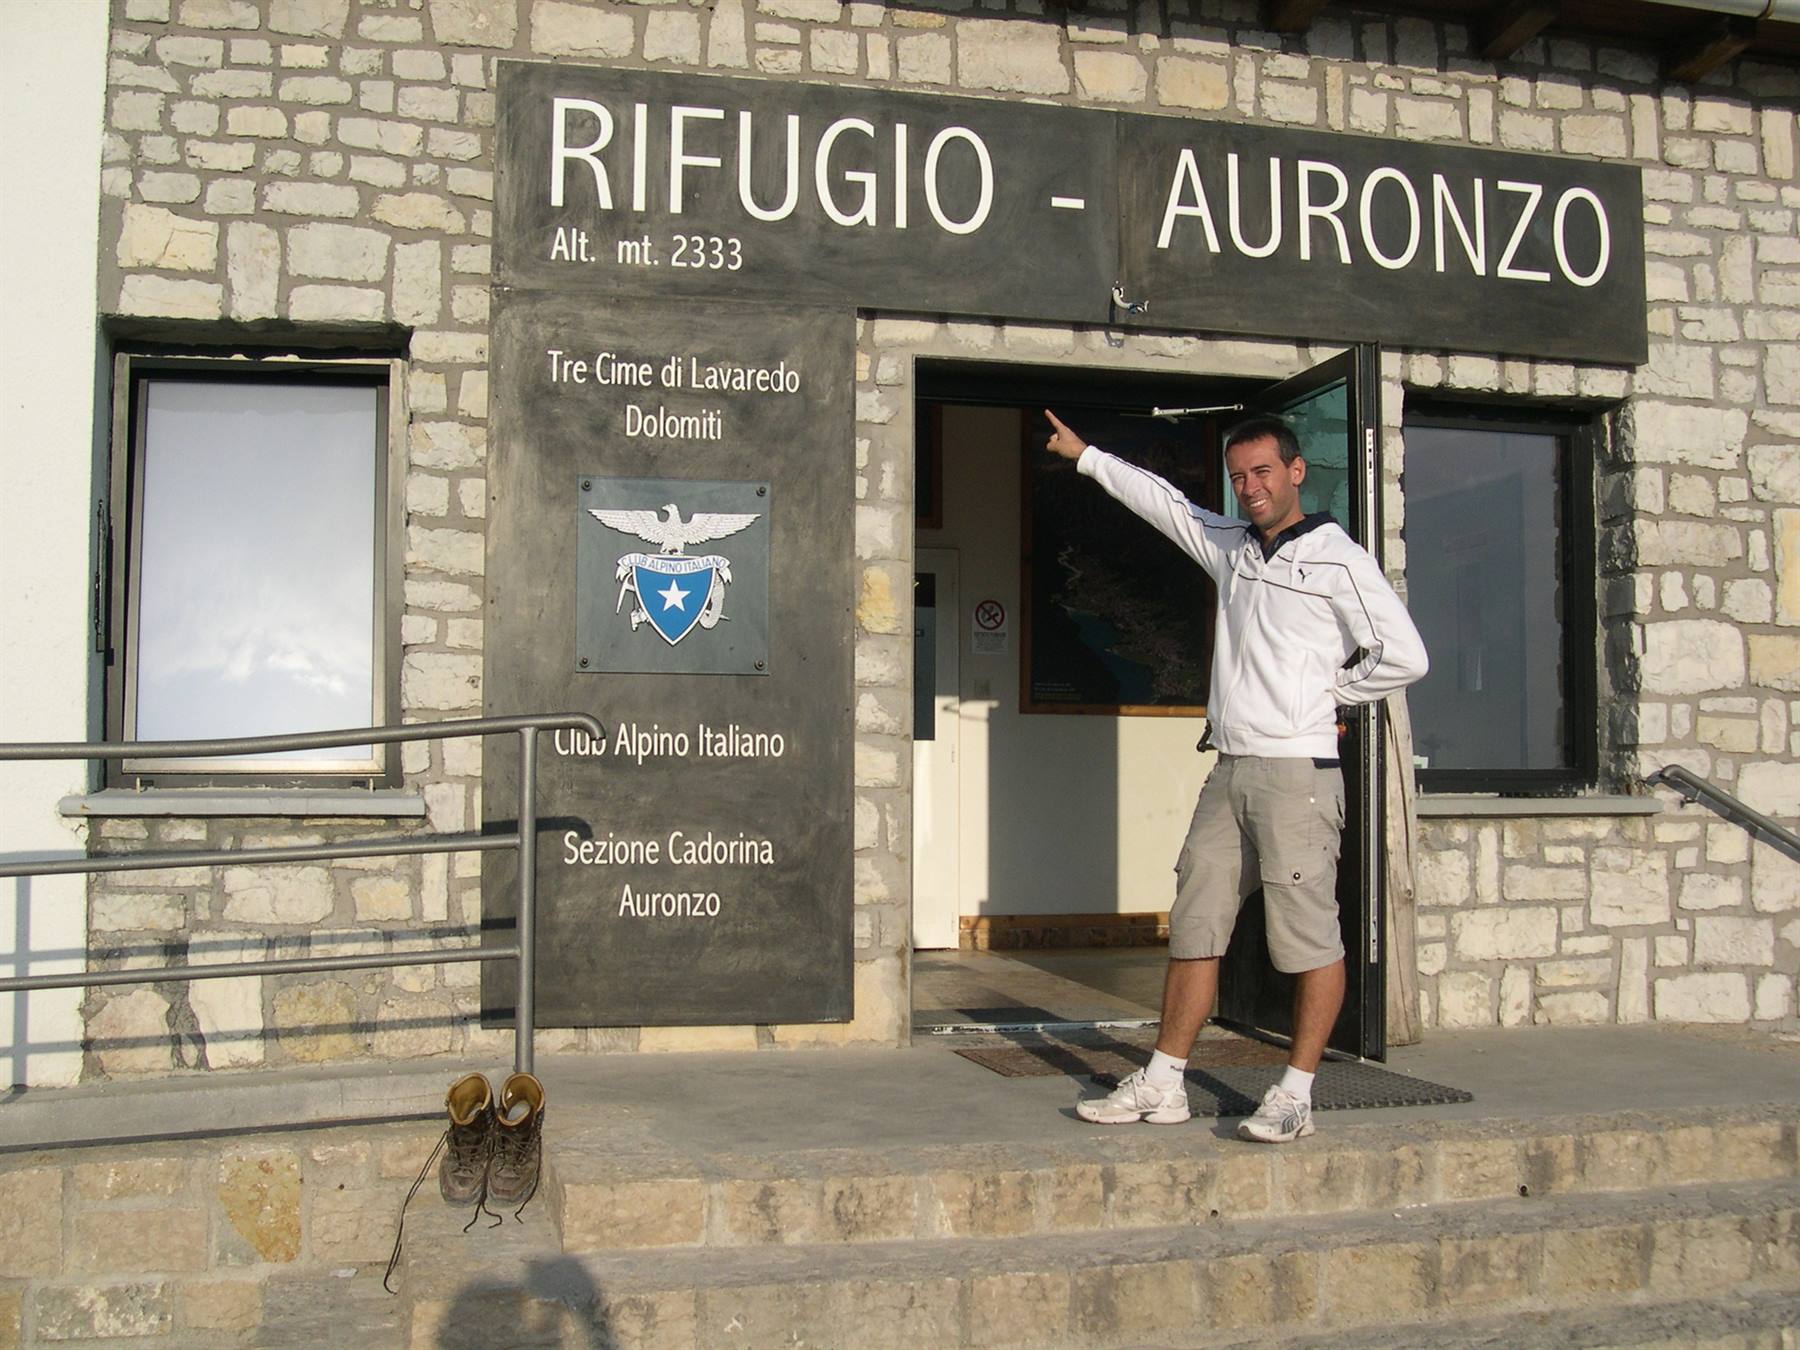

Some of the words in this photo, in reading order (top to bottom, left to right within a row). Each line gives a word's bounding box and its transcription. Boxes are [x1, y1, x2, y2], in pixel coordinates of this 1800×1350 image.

[550, 97, 995, 236] RIFUGIO
[1156, 148, 1612, 288] AURONZO
[550, 226, 597, 263] Alt.
[617, 234, 660, 268] mt.
[670, 234, 744, 271] 2333
[547, 349, 588, 384] Tre
[595, 351, 653, 387] Cime
[660, 355, 682, 388] di
[691, 356, 800, 394] Lavaredo
[625, 404, 722, 441] Dolomiti
[621, 555, 649, 568] CLUB
[648, 560, 681, 573] ALPINO
[683, 558, 727, 573] ITALIANO
[614, 722, 690, 766] Alpino
[698, 723, 785, 758] Italiano
[563, 830, 660, 865] Sezione
[668, 830, 775, 865] Cadorina
[618, 883, 721, 918] Auronzo
